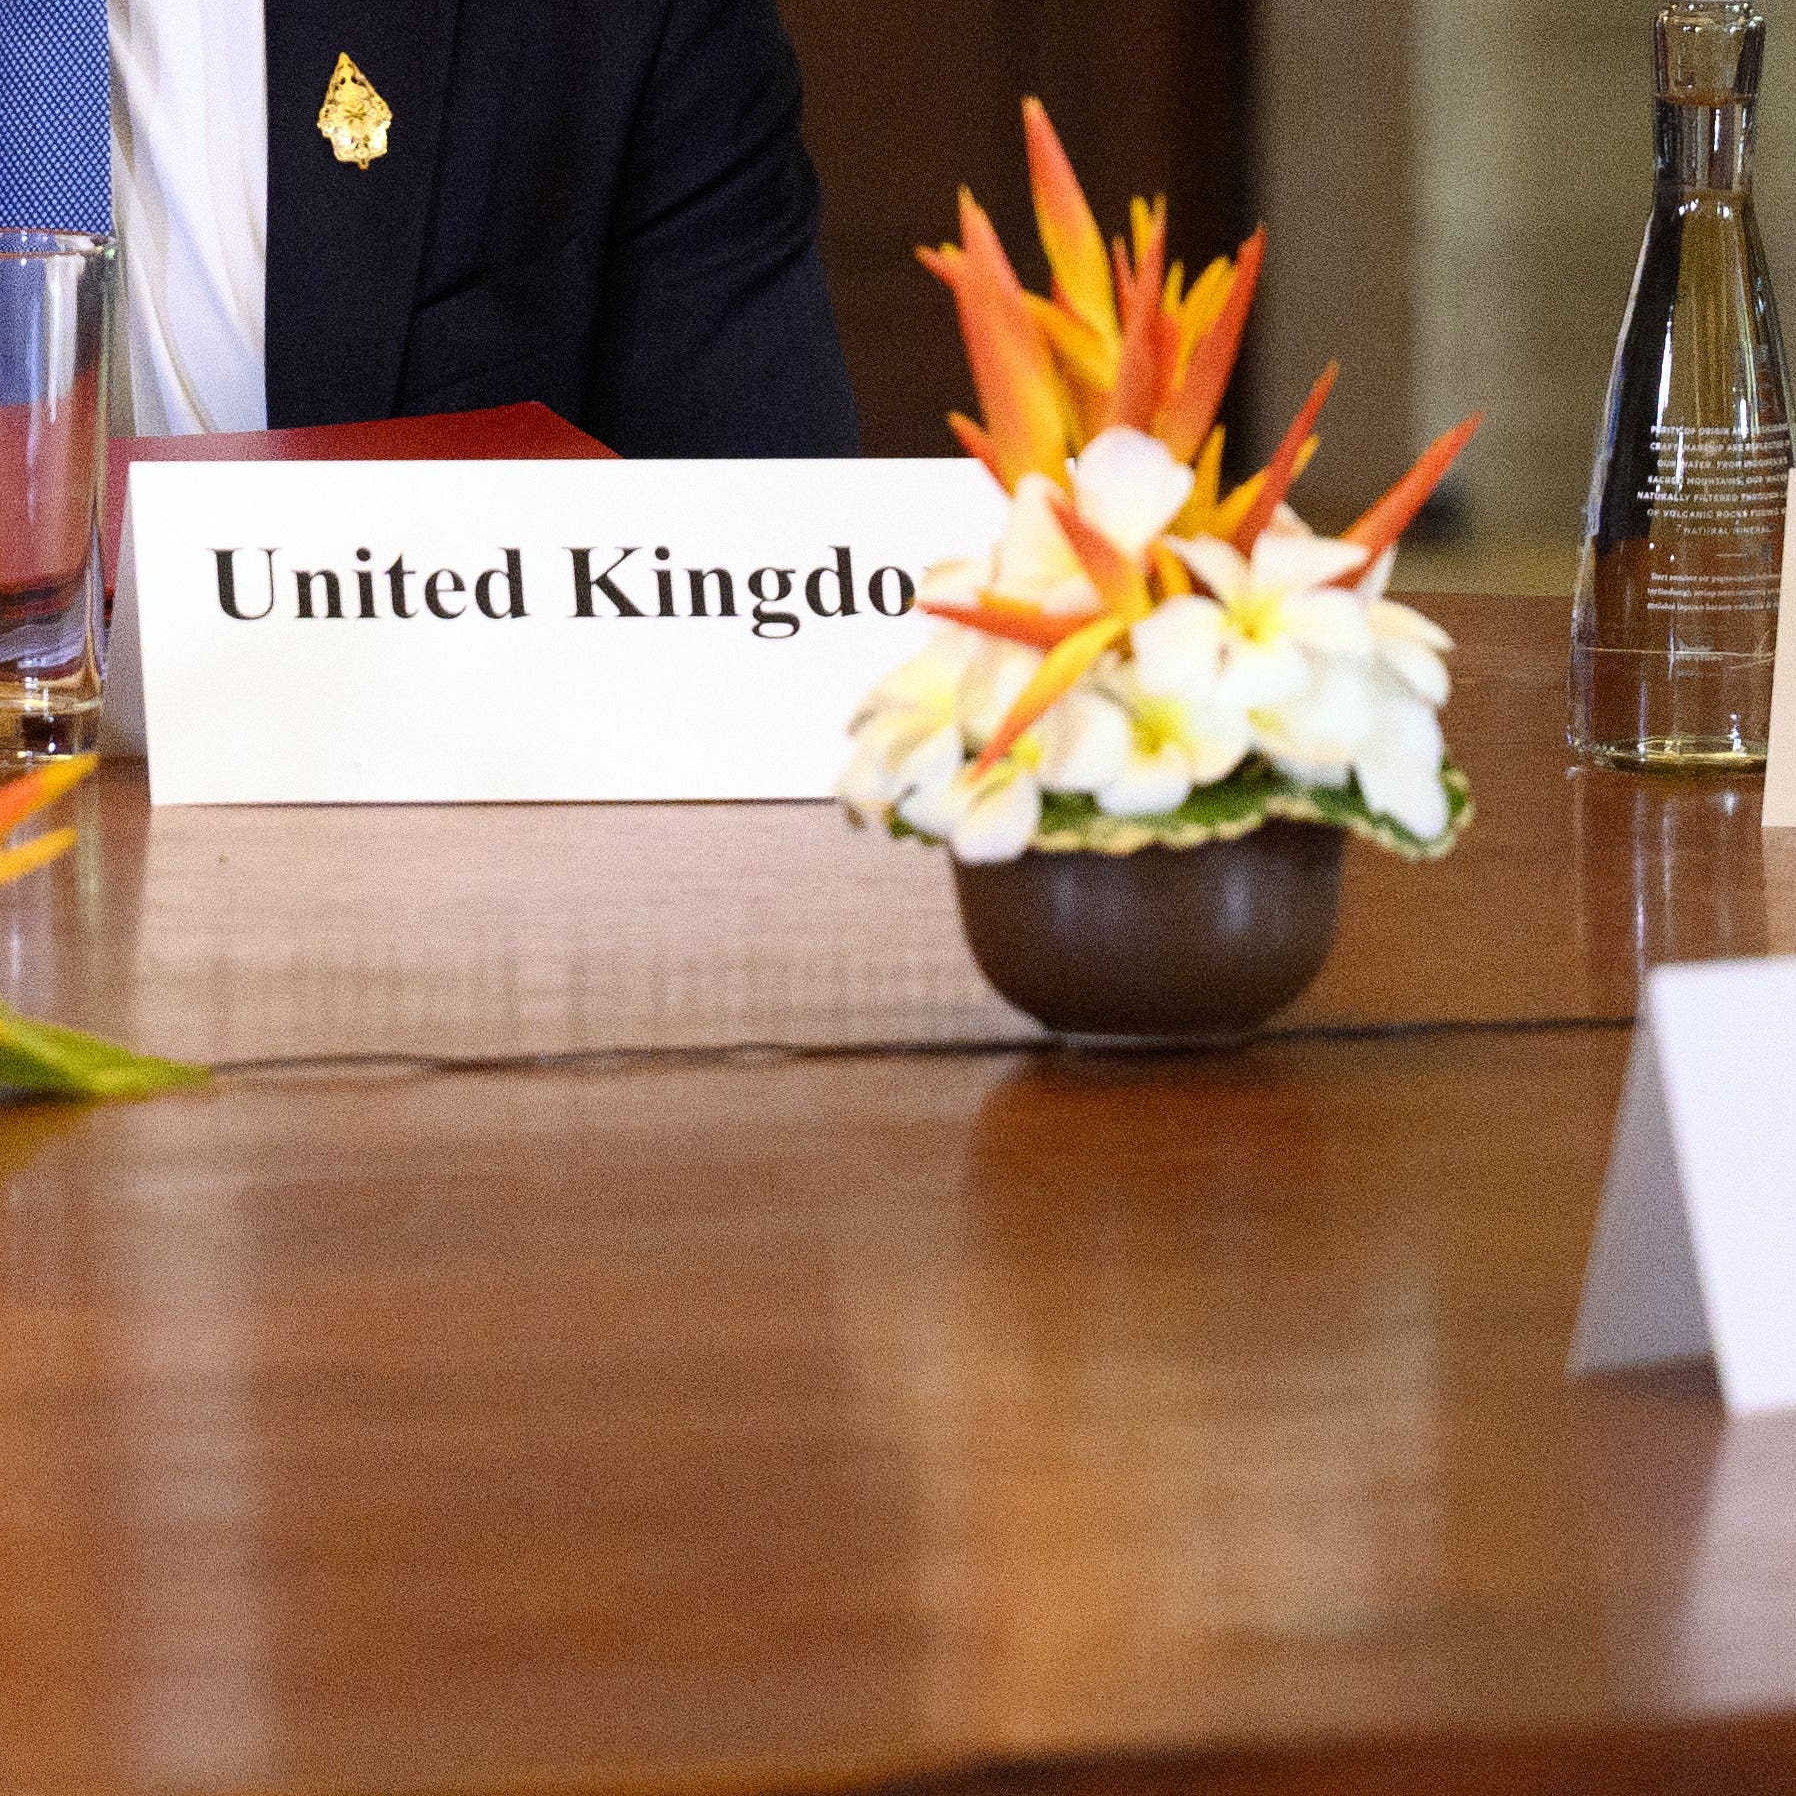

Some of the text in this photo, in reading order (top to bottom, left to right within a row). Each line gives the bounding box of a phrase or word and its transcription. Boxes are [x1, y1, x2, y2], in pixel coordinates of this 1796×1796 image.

[1637, 491, 1690, 502] NATURALLY
[1663, 510, 1713, 519] VOLCANIC
[1684, 526, 1729, 535] NATURAL
[206, 545, 918, 640] United Kingdo
